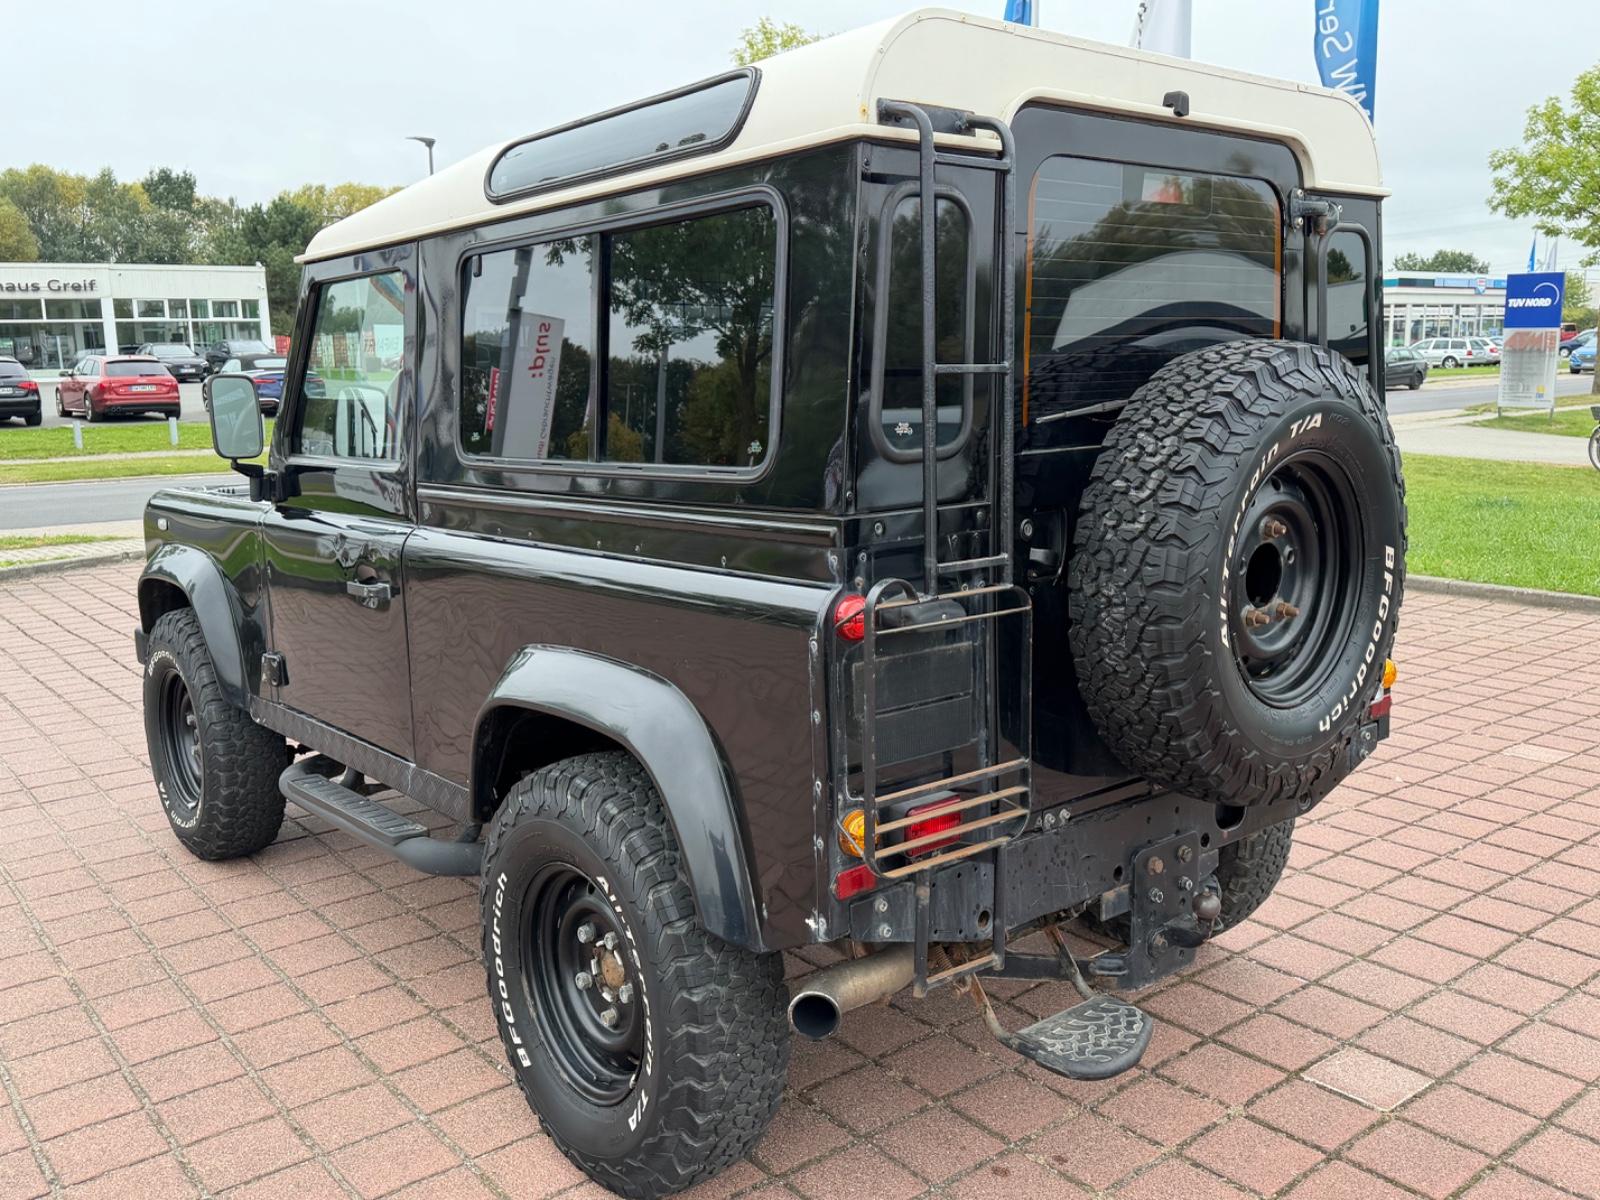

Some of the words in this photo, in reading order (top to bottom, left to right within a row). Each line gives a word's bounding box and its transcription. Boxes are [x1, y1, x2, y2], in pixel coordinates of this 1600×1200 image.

[47, 279, 96, 292] Greif
[1524, 297, 1552, 307] NORD
[1290, 412, 1323, 439] T/A
[1318, 545, 1396, 732] BFGoodrich
[492, 871, 532, 1068] BFGoodrich
[627, 1088, 649, 1132] T/A
